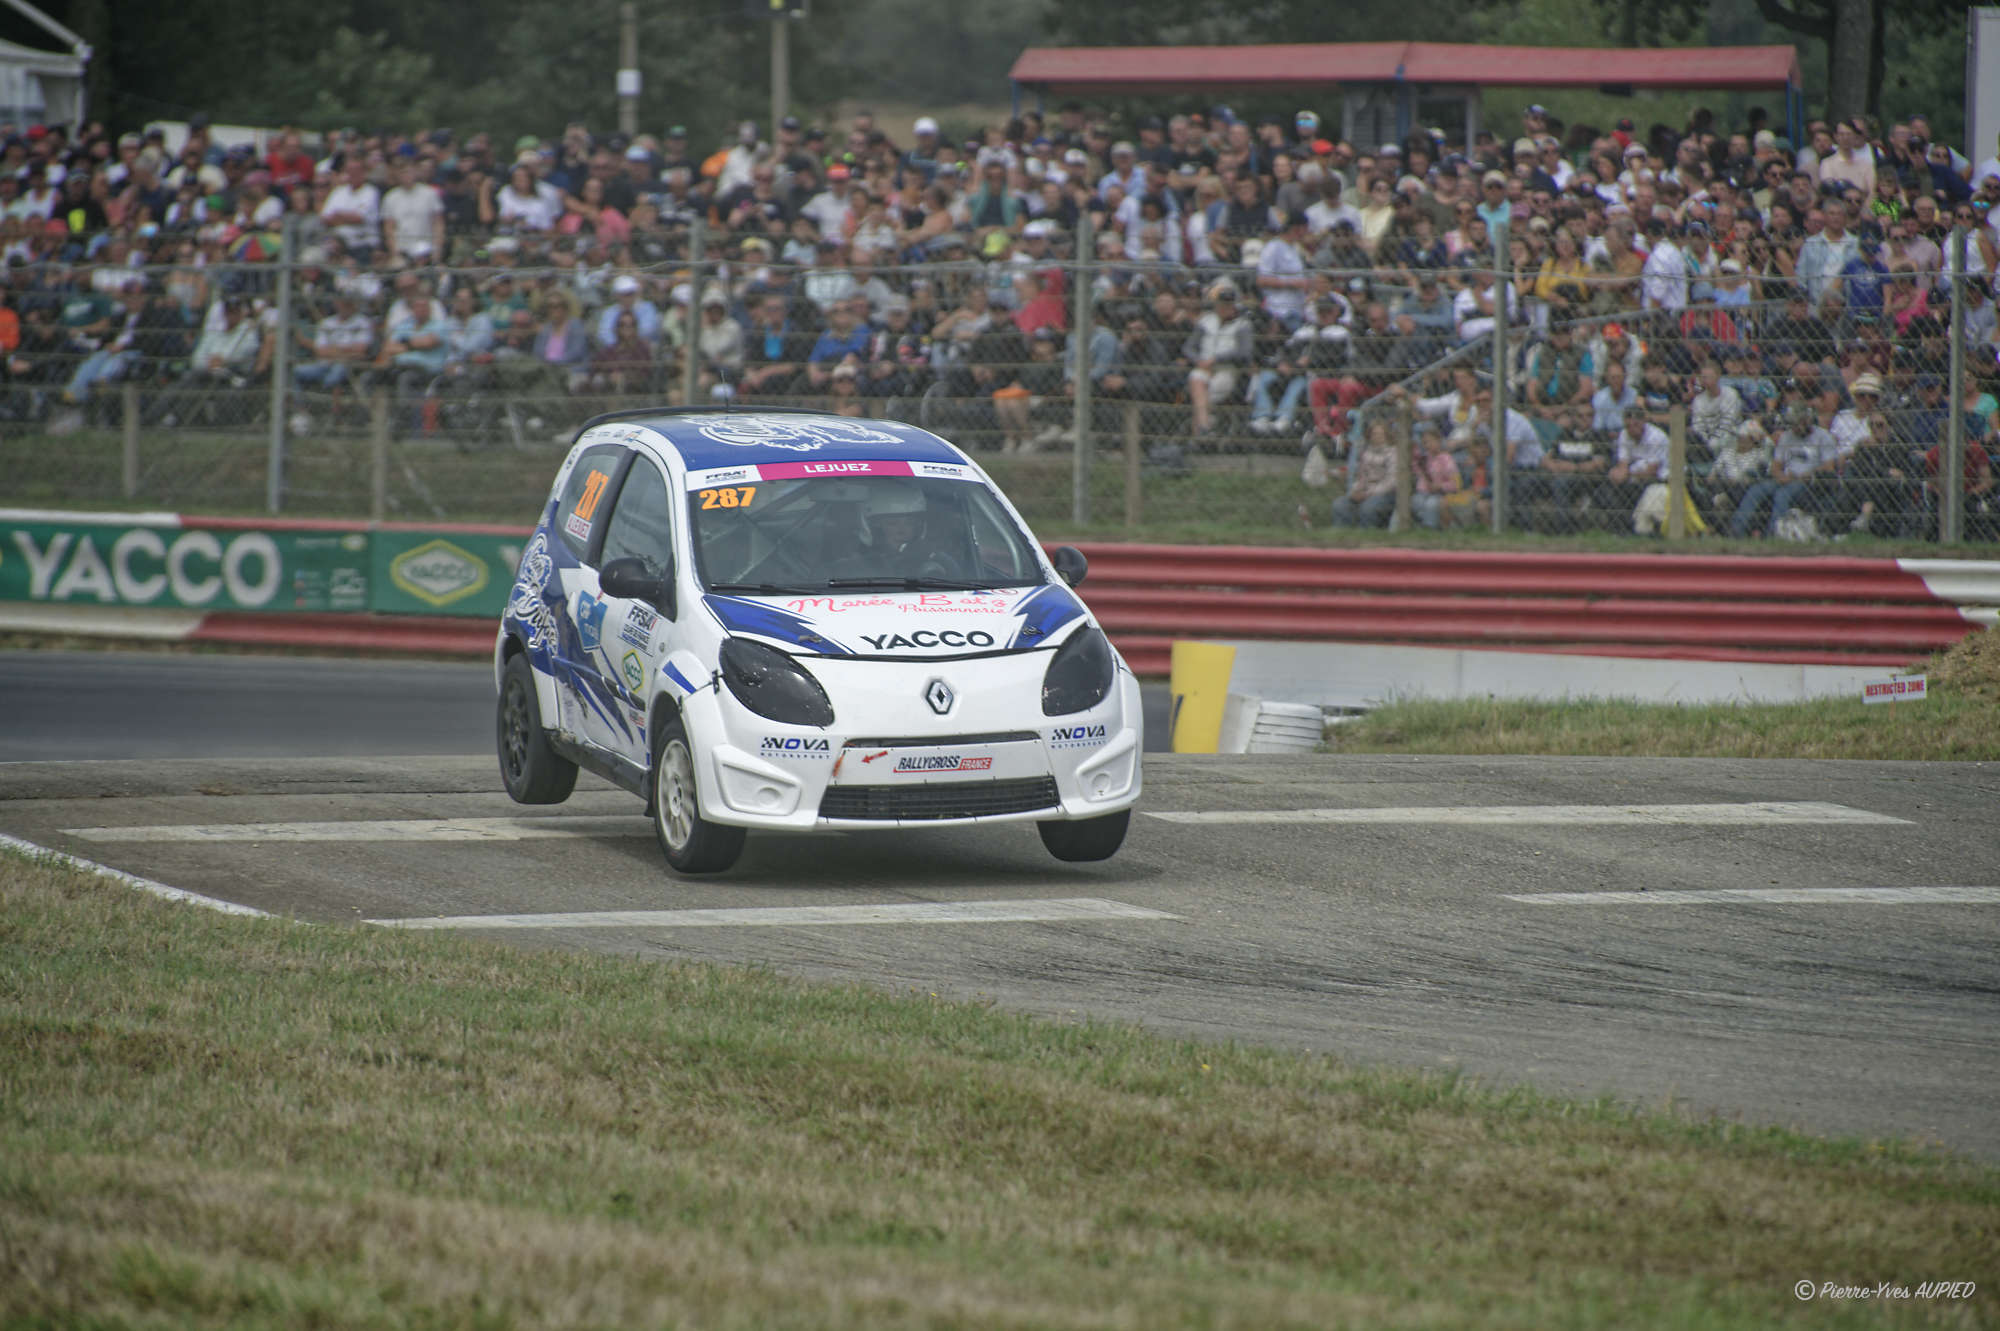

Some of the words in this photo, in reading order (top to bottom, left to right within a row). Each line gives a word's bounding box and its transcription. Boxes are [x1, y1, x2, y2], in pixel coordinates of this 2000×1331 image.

[706, 470, 742, 480] FFSA
[804, 463, 872, 473] LEJUEZ
[923, 465, 958, 473] FFSA
[575, 470, 608, 521] 287
[699, 486, 757, 510] 287
[11, 528, 282, 607] YACCO
[409, 562, 477, 581] YACCO
[787, 595, 896, 613] Marée
[898, 603, 1006, 614] Poissonnerie
[628, 604, 653, 631] FFSA
[859, 630, 994, 650] YACCO
[1866, 682, 1906, 696] RESTRICTED
[1907, 680, 1925, 693] ZONE
[1053, 725, 1106, 740] NOVA
[762, 737, 830, 750] NOVA
[1051, 740, 1106, 749] MOTORSPORT
[898, 756, 961, 769] RALLYCROSS
[961, 758, 991, 770] FRANCE
